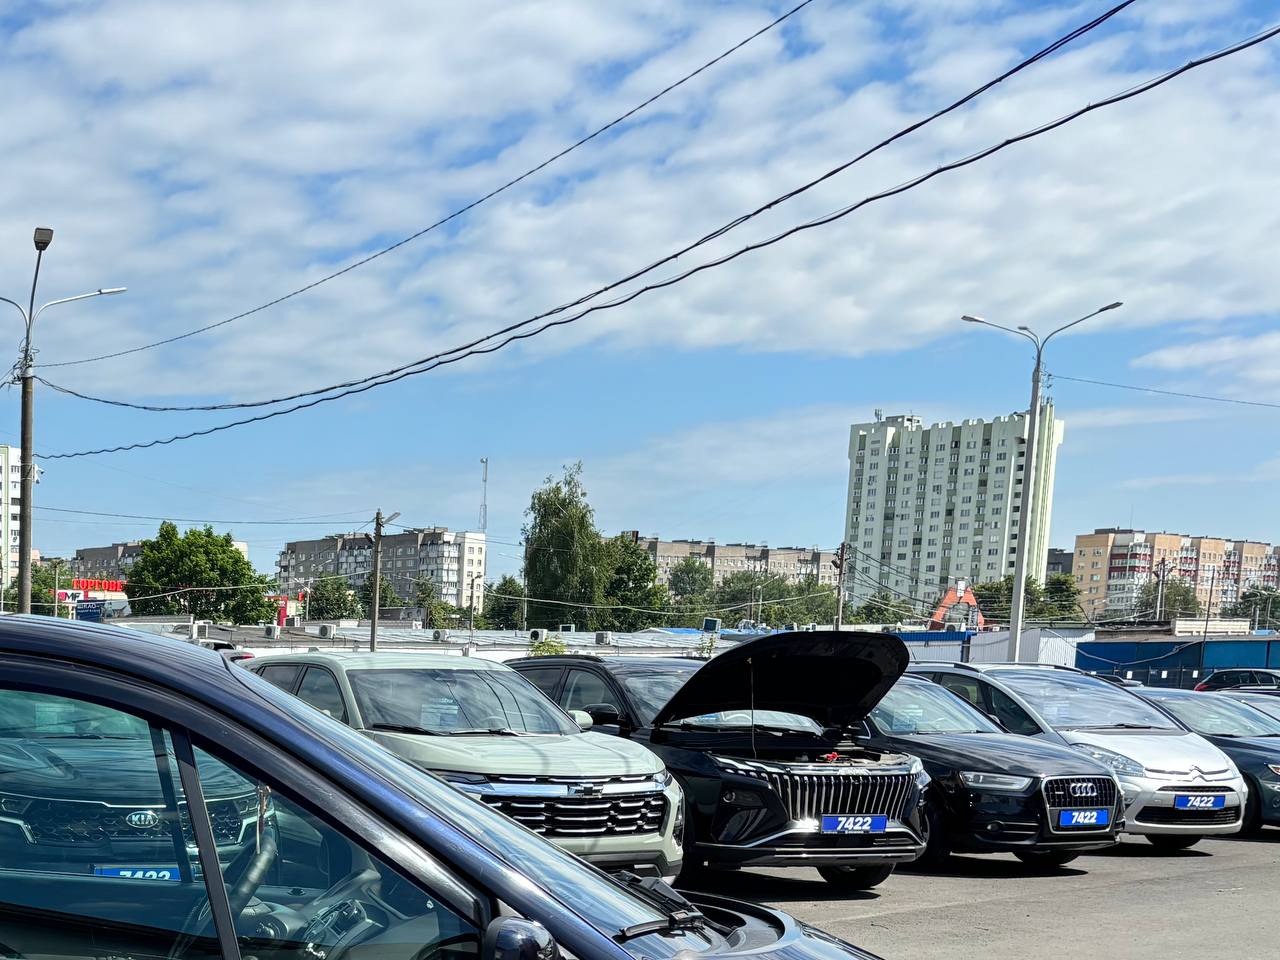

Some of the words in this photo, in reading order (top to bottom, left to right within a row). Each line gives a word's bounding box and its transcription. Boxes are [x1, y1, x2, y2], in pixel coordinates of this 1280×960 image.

[1187, 796, 1215, 807] 7422
[836, 816, 872, 831] 7422
[1071, 811, 1097, 824] 7422
